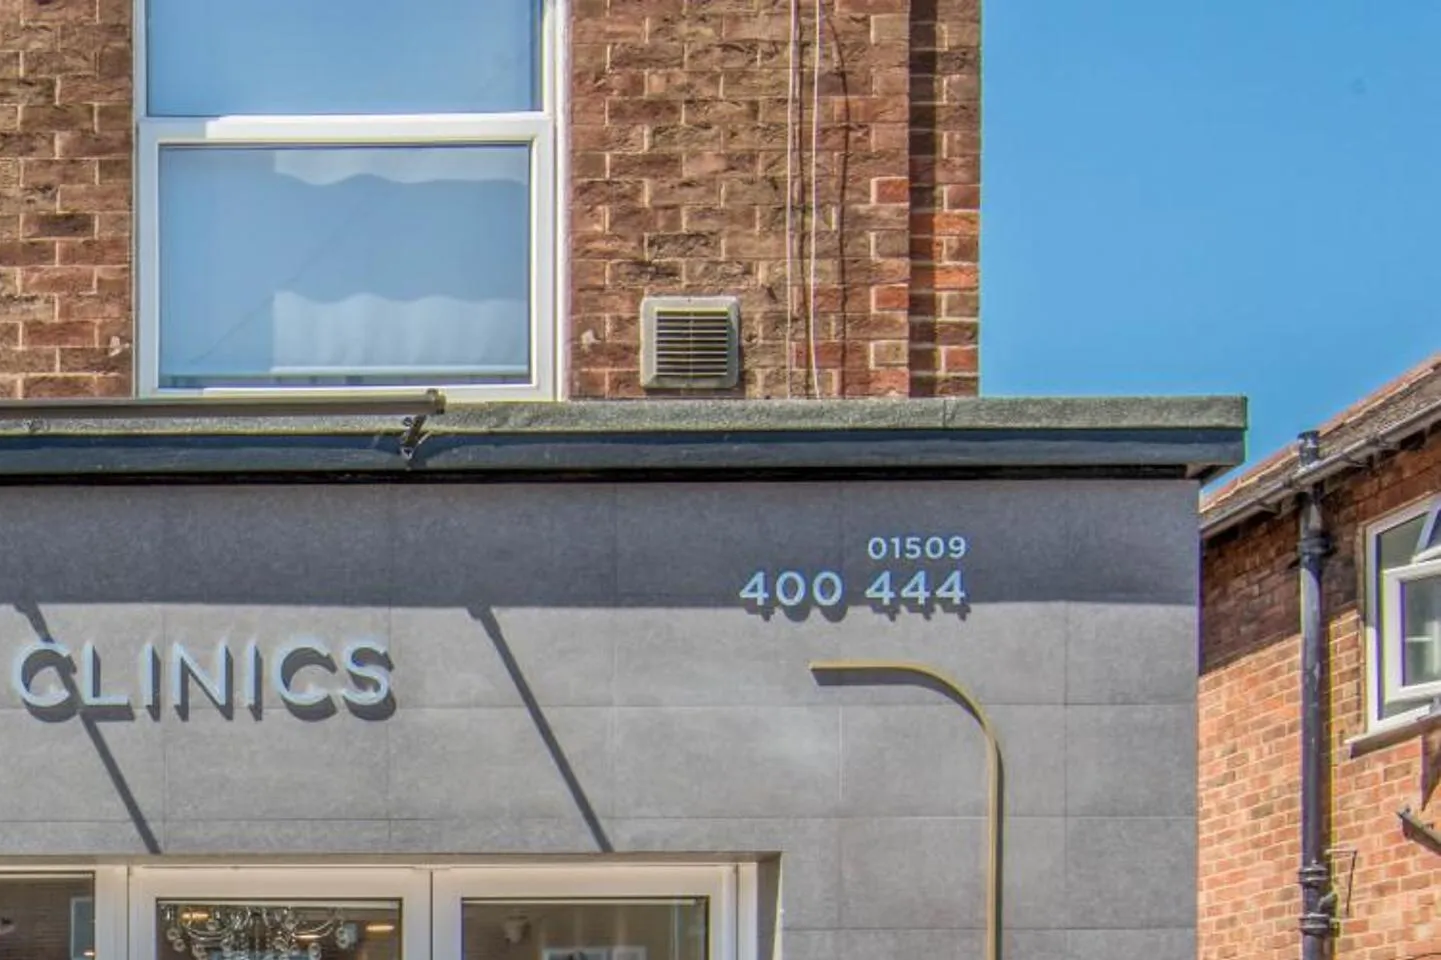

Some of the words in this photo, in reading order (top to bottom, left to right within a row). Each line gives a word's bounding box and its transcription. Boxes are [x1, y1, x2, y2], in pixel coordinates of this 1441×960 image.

[867, 535, 967, 560] 01509
[738, 569, 844, 607] 400
[864, 569, 966, 606] 444
[11, 639, 392, 709] CLINICS
